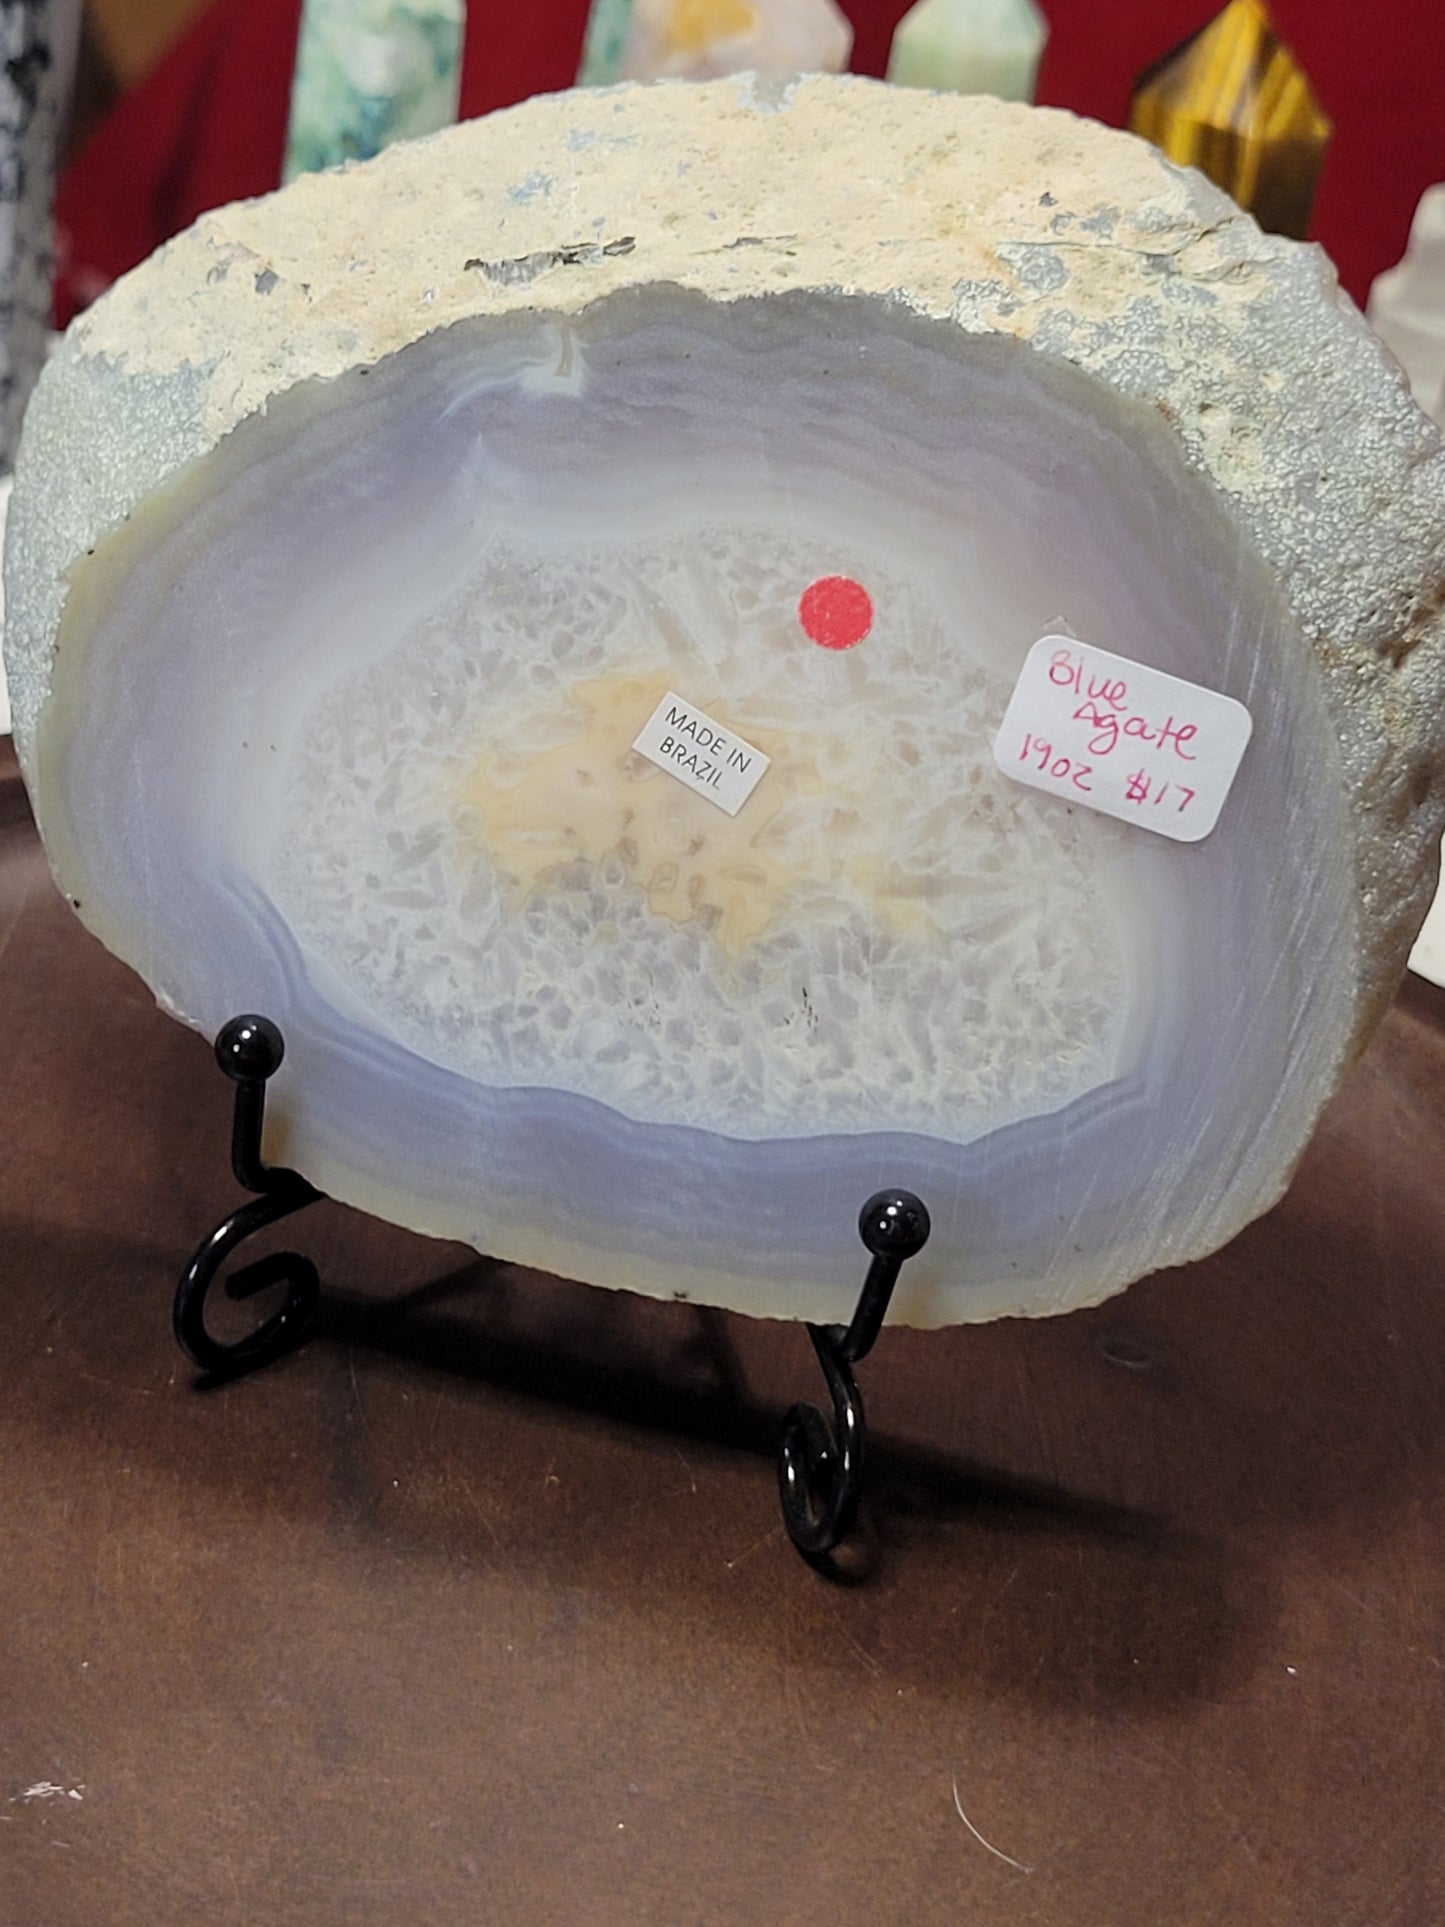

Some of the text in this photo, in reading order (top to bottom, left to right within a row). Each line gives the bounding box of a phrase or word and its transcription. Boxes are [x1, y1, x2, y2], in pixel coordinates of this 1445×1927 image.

[1049, 650, 1128, 711] Blue
[664, 706, 752, 773] MADE IN
[1072, 701, 1198, 760] Agate
[659, 736, 723, 790] BRAZIL
[1125, 768, 1196, 812] $17
